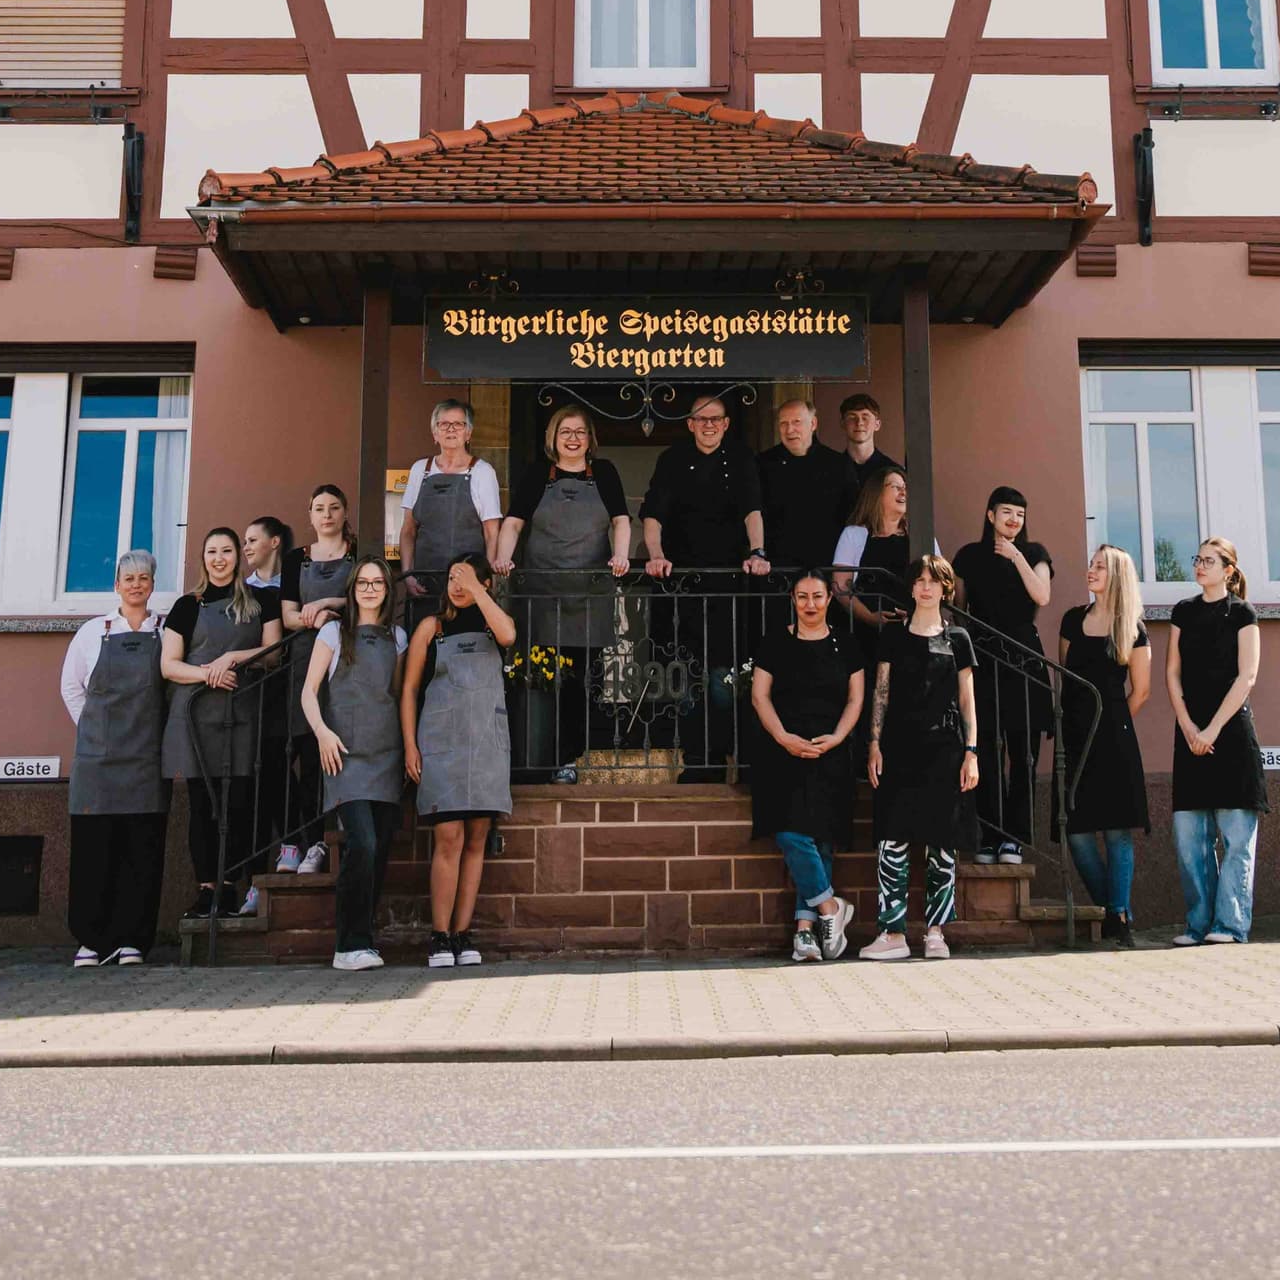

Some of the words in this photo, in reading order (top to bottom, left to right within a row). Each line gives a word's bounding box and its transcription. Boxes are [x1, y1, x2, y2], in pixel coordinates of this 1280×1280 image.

[443, 308, 609, 343] Bürgerliche
[619, 308, 851, 343] Speisegaststätte
[570, 342, 726, 376] Biergarten
[605, 660, 688, 701] 1890
[3, 761, 51, 776] Gäste
